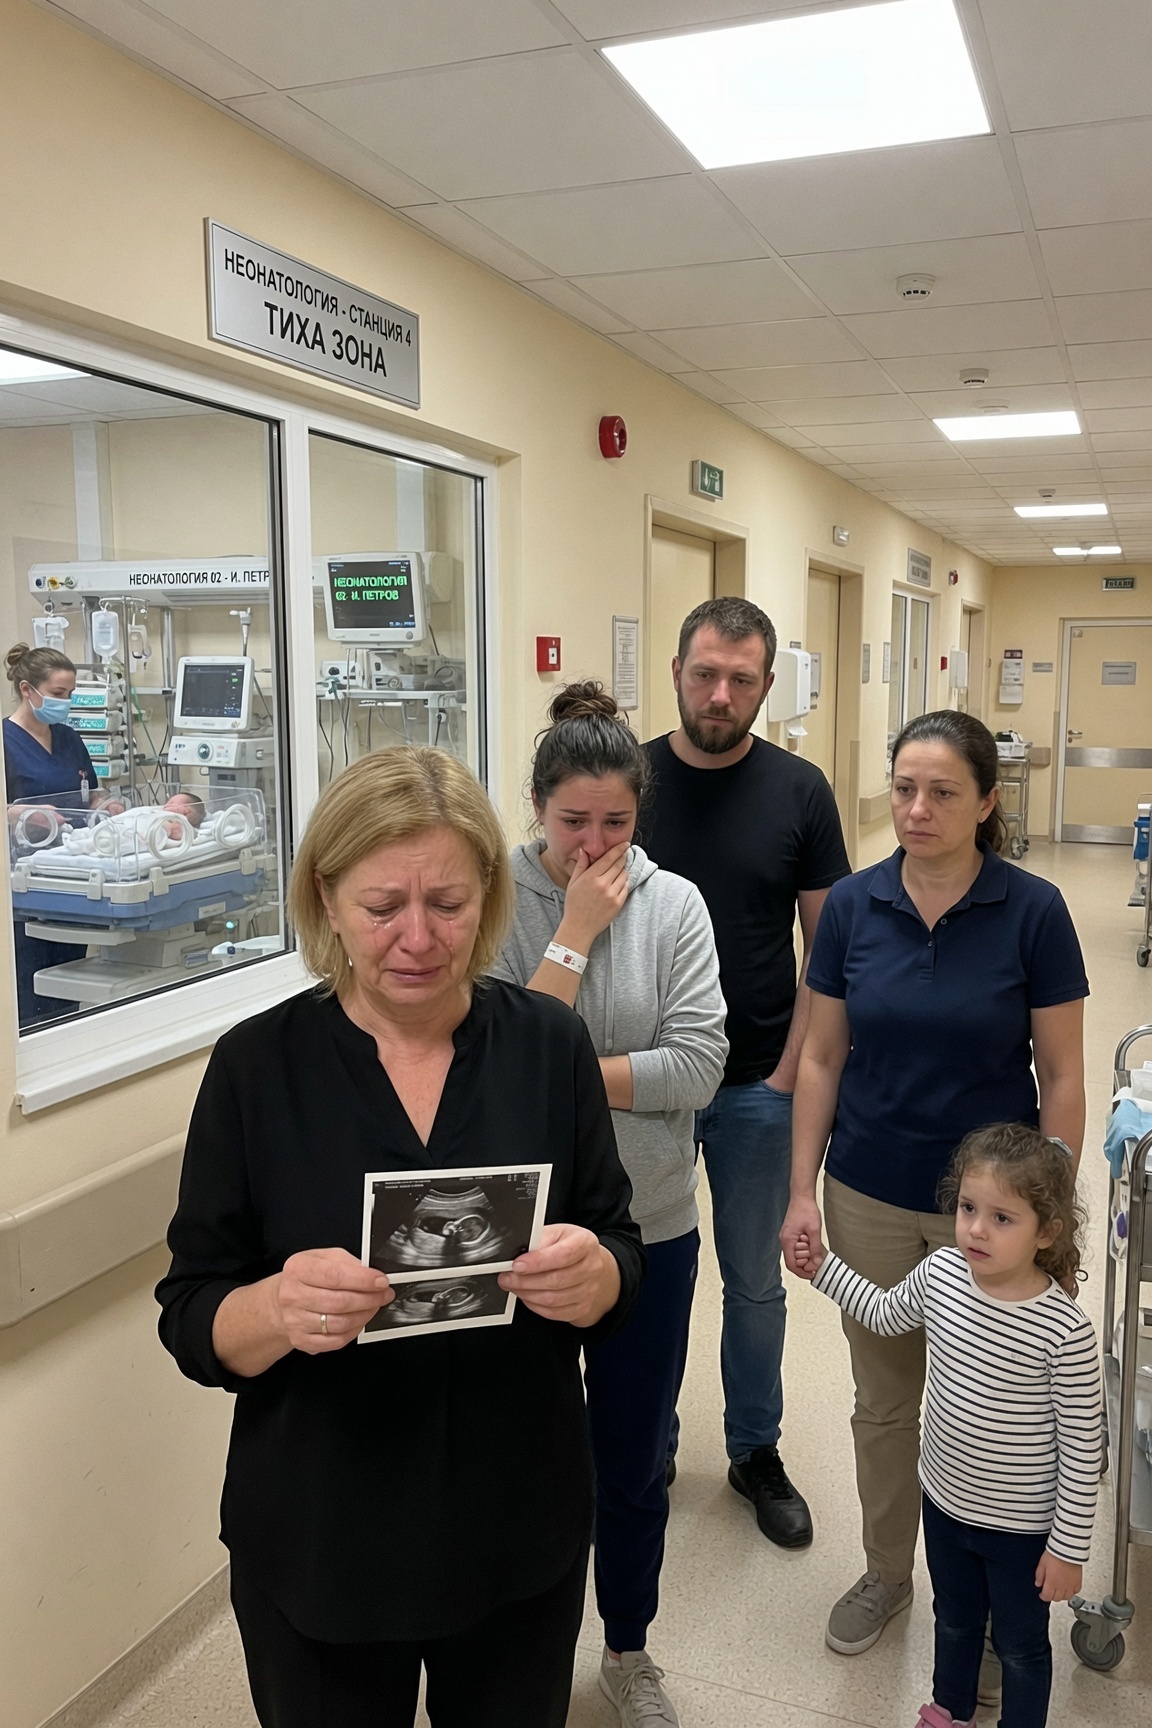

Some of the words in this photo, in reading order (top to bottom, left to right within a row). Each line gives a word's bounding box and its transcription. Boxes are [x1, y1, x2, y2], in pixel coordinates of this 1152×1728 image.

[224, 248, 338, 316] НЕОНАТОЛОГИЯ
[349, 303, 403, 344] СТАНЦИЯ
[405, 329, 412, 347] 4
[264, 301, 326, 354] ТИХА
[332, 329, 387, 377] ЗОНА
[129, 572, 208, 585] НЕОНАТОЛОГИЯ
[210, 572, 222, 583] 02
